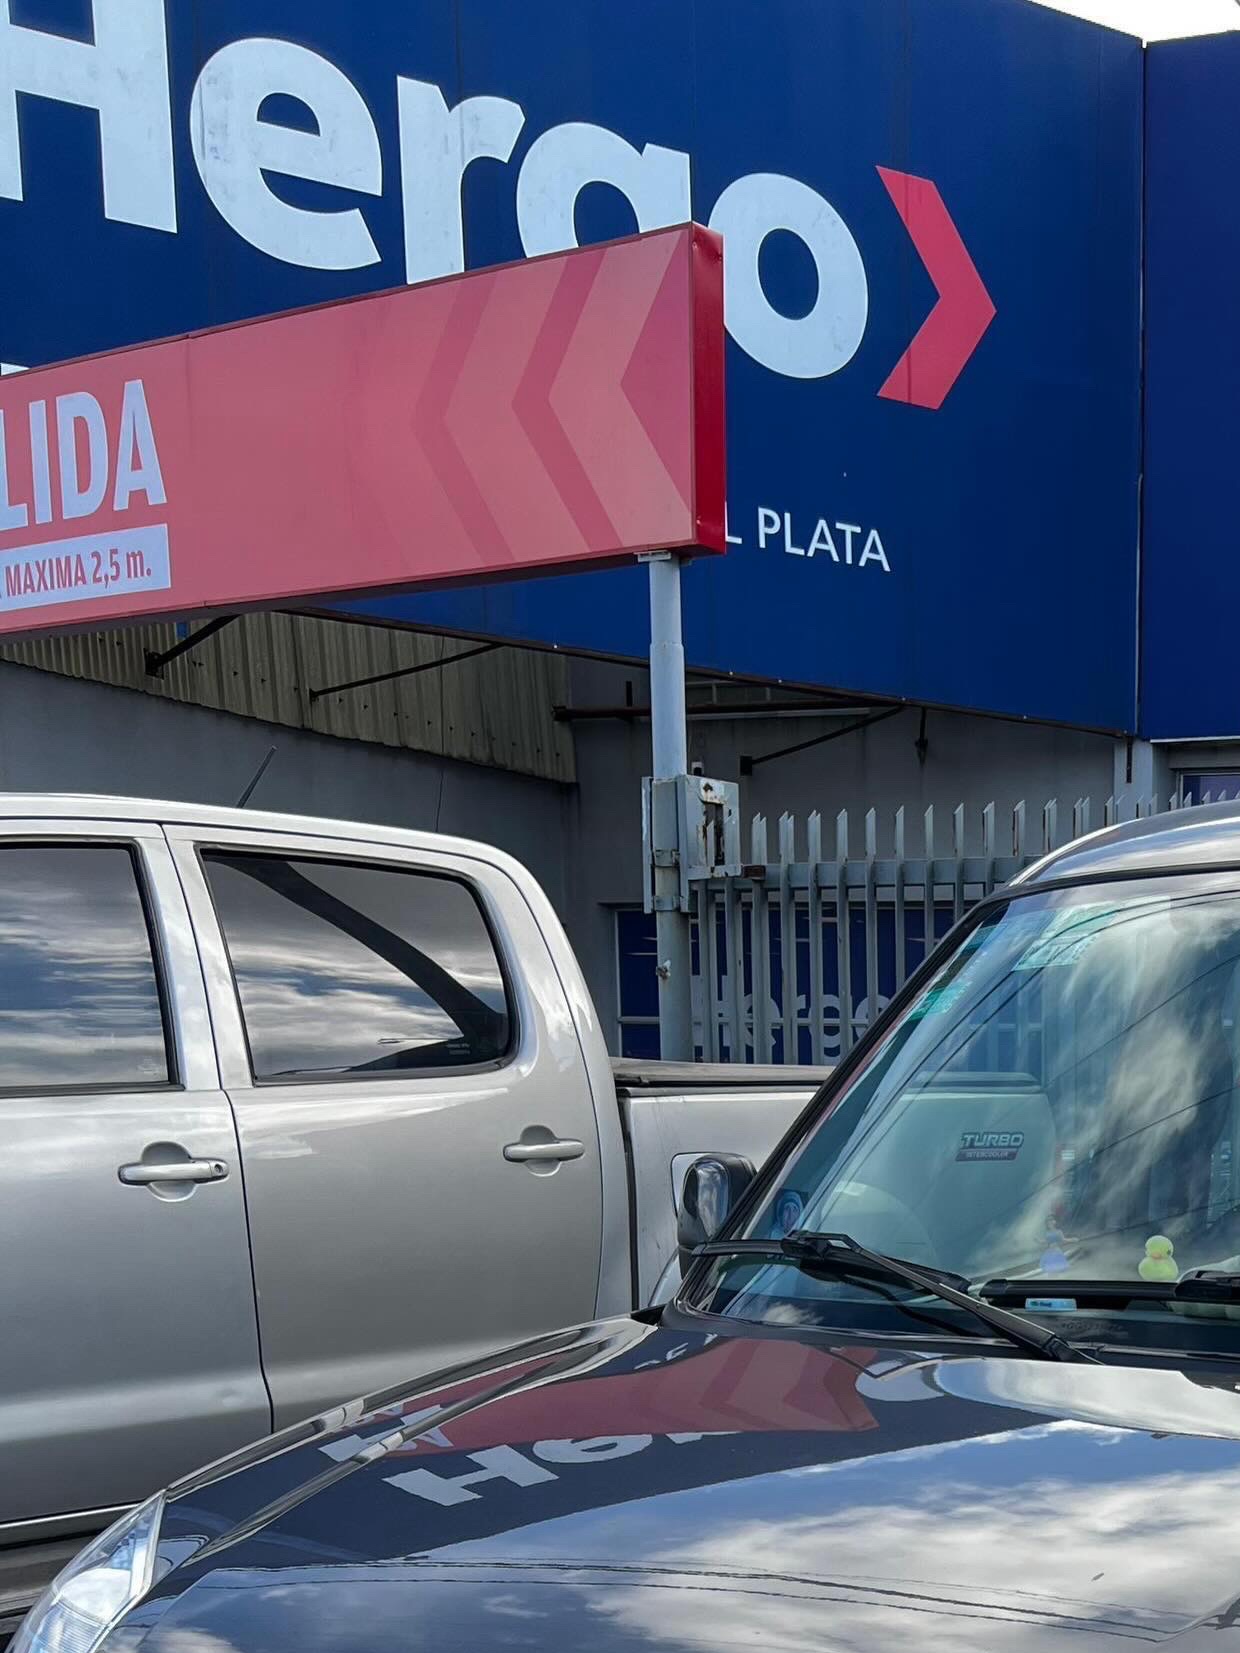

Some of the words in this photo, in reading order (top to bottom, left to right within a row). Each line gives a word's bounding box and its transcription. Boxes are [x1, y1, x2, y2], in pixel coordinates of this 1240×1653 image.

[0, 379, 167, 530] LIDA
[758, 506, 891, 572] PLATA
[5, 554, 87, 597] MAXIMA
[91, 548, 121, 588] 2,5
[126, 550, 152, 579] m.
[962, 1133, 1023, 1148] TURBO
